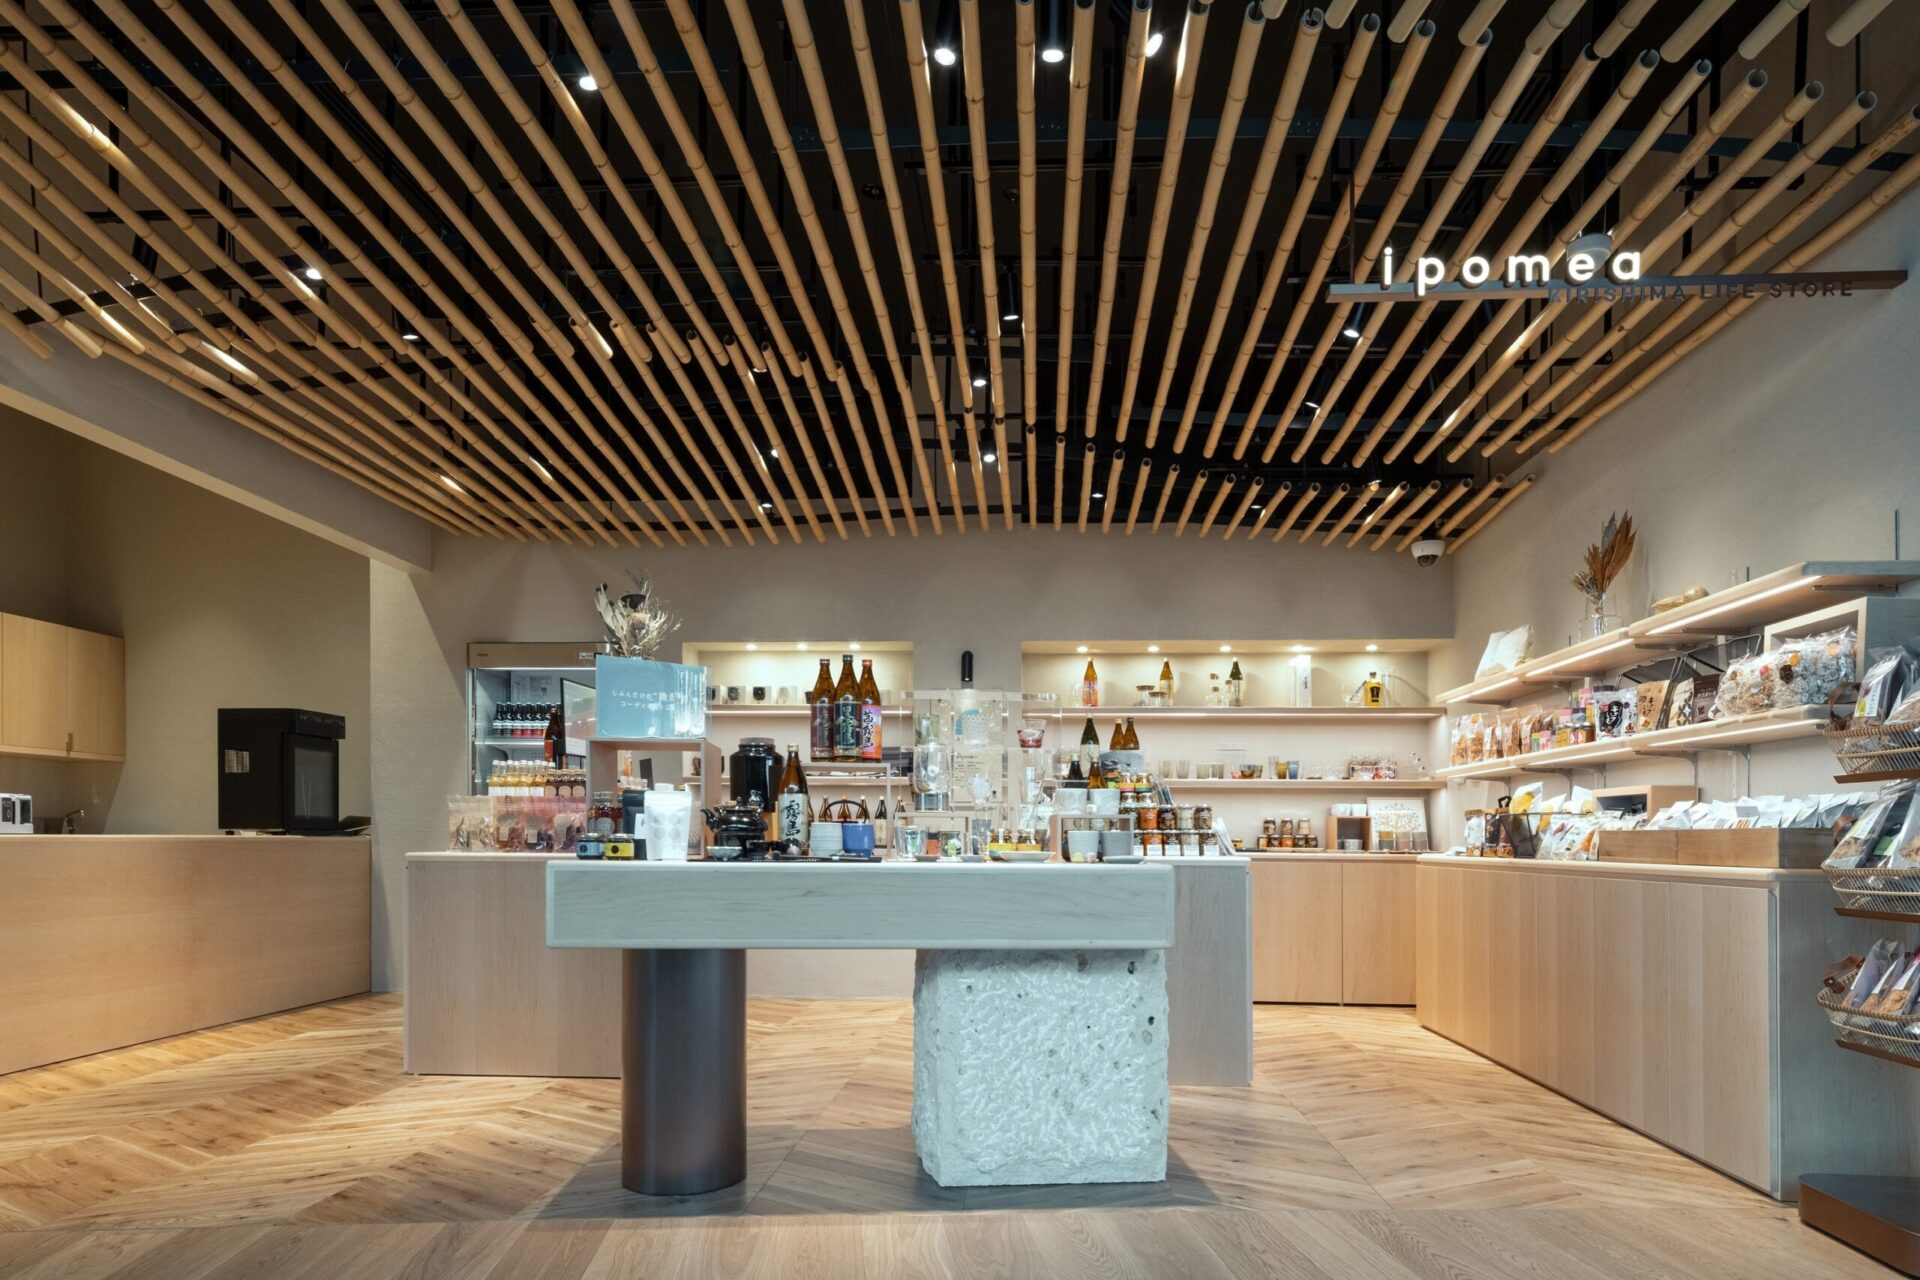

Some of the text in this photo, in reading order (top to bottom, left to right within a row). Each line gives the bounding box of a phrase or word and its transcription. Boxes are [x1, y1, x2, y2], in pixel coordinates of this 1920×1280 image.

[1383, 246, 1642, 297] ipomea
[1549, 281, 1854, 304] KIRISHIMA LIFE STORE
[781, 799, 801, 837] 霧島
